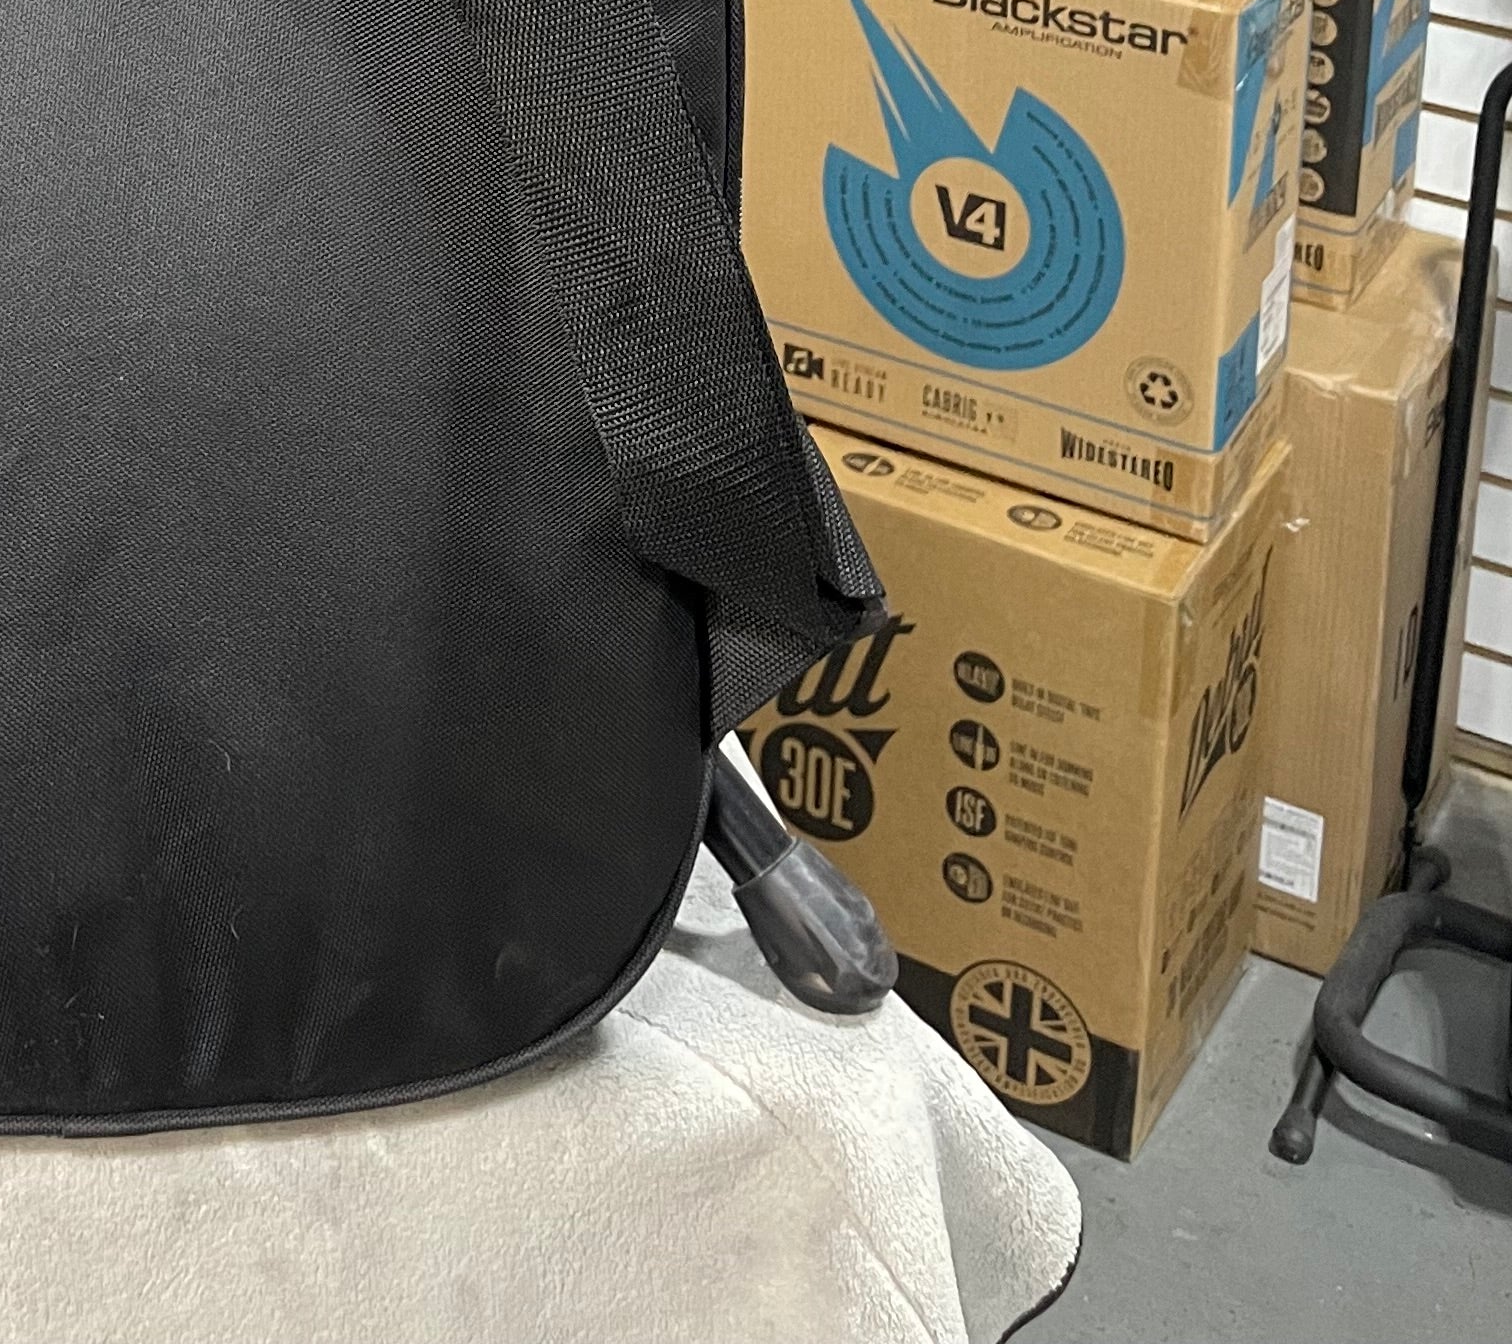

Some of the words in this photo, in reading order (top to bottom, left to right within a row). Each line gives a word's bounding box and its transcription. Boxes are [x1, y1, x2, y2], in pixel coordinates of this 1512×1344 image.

[991, 21, 1123, 61] AMPLIFICATION
[935, 184, 1006, 251] V4
[1061, 427, 1174, 492] WIDESTEREO
[779, 736, 857, 831] 30E
[954, 790, 987, 832] ISF
